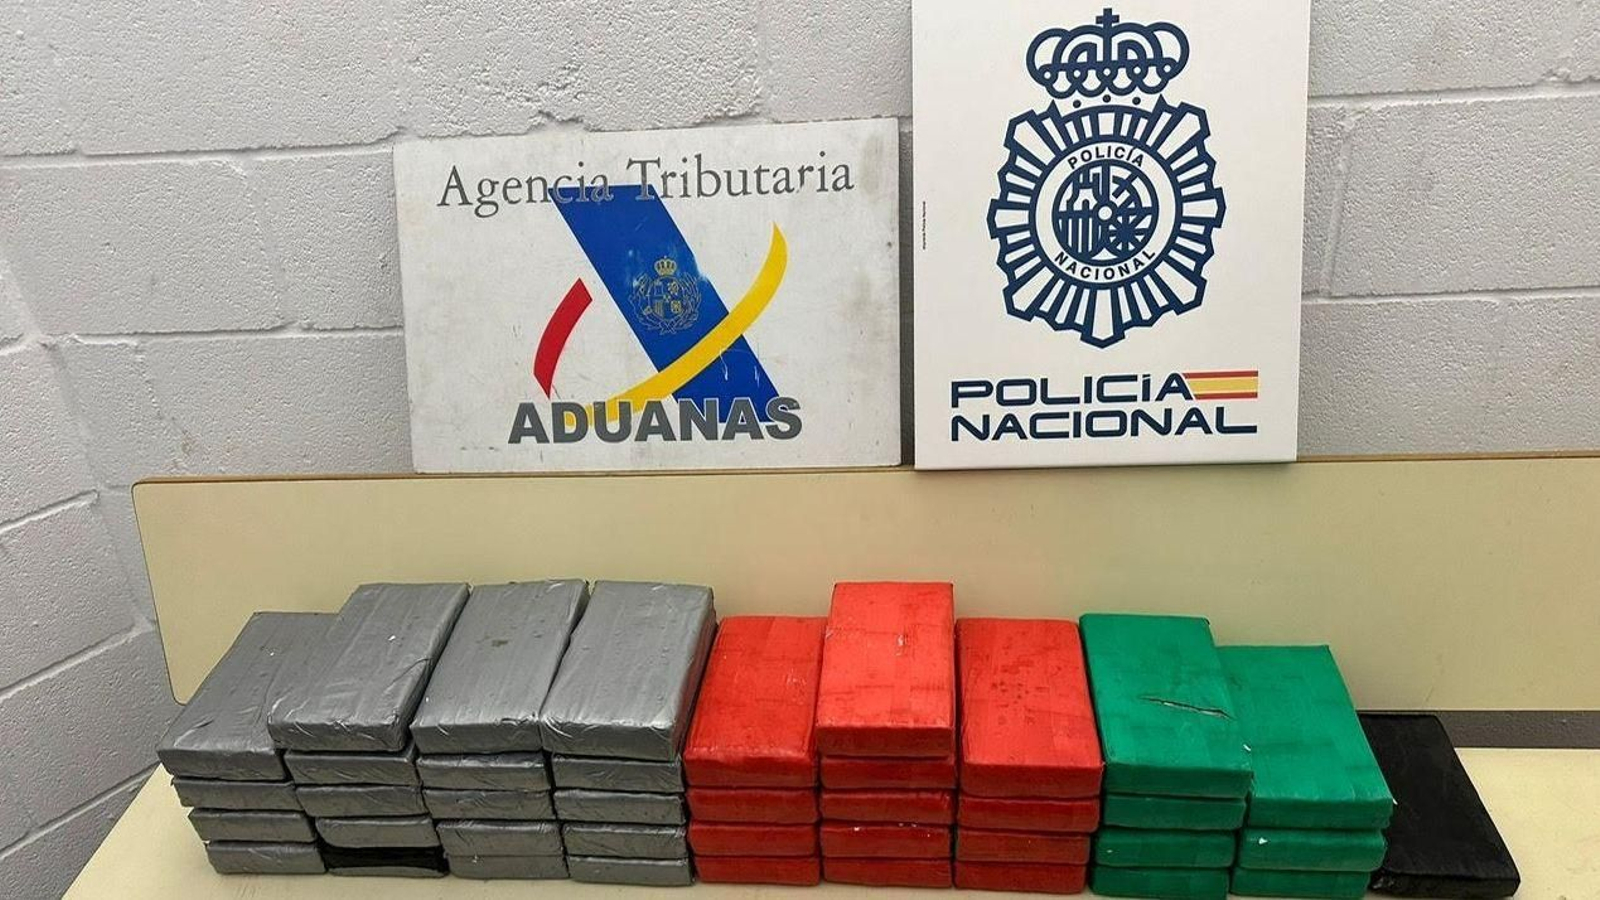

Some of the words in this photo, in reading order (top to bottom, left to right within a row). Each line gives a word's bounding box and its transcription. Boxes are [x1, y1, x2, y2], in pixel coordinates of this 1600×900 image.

[1067, 146, 1144, 169] POLICÍA
[437, 160, 614, 218] Agencia
[626, 151, 855, 201] Tributaria
[1054, 251, 1156, 280] NACIONAL
[507, 396, 803, 444] ADUANAS
[951, 406, 1258, 442] NACIONAL
